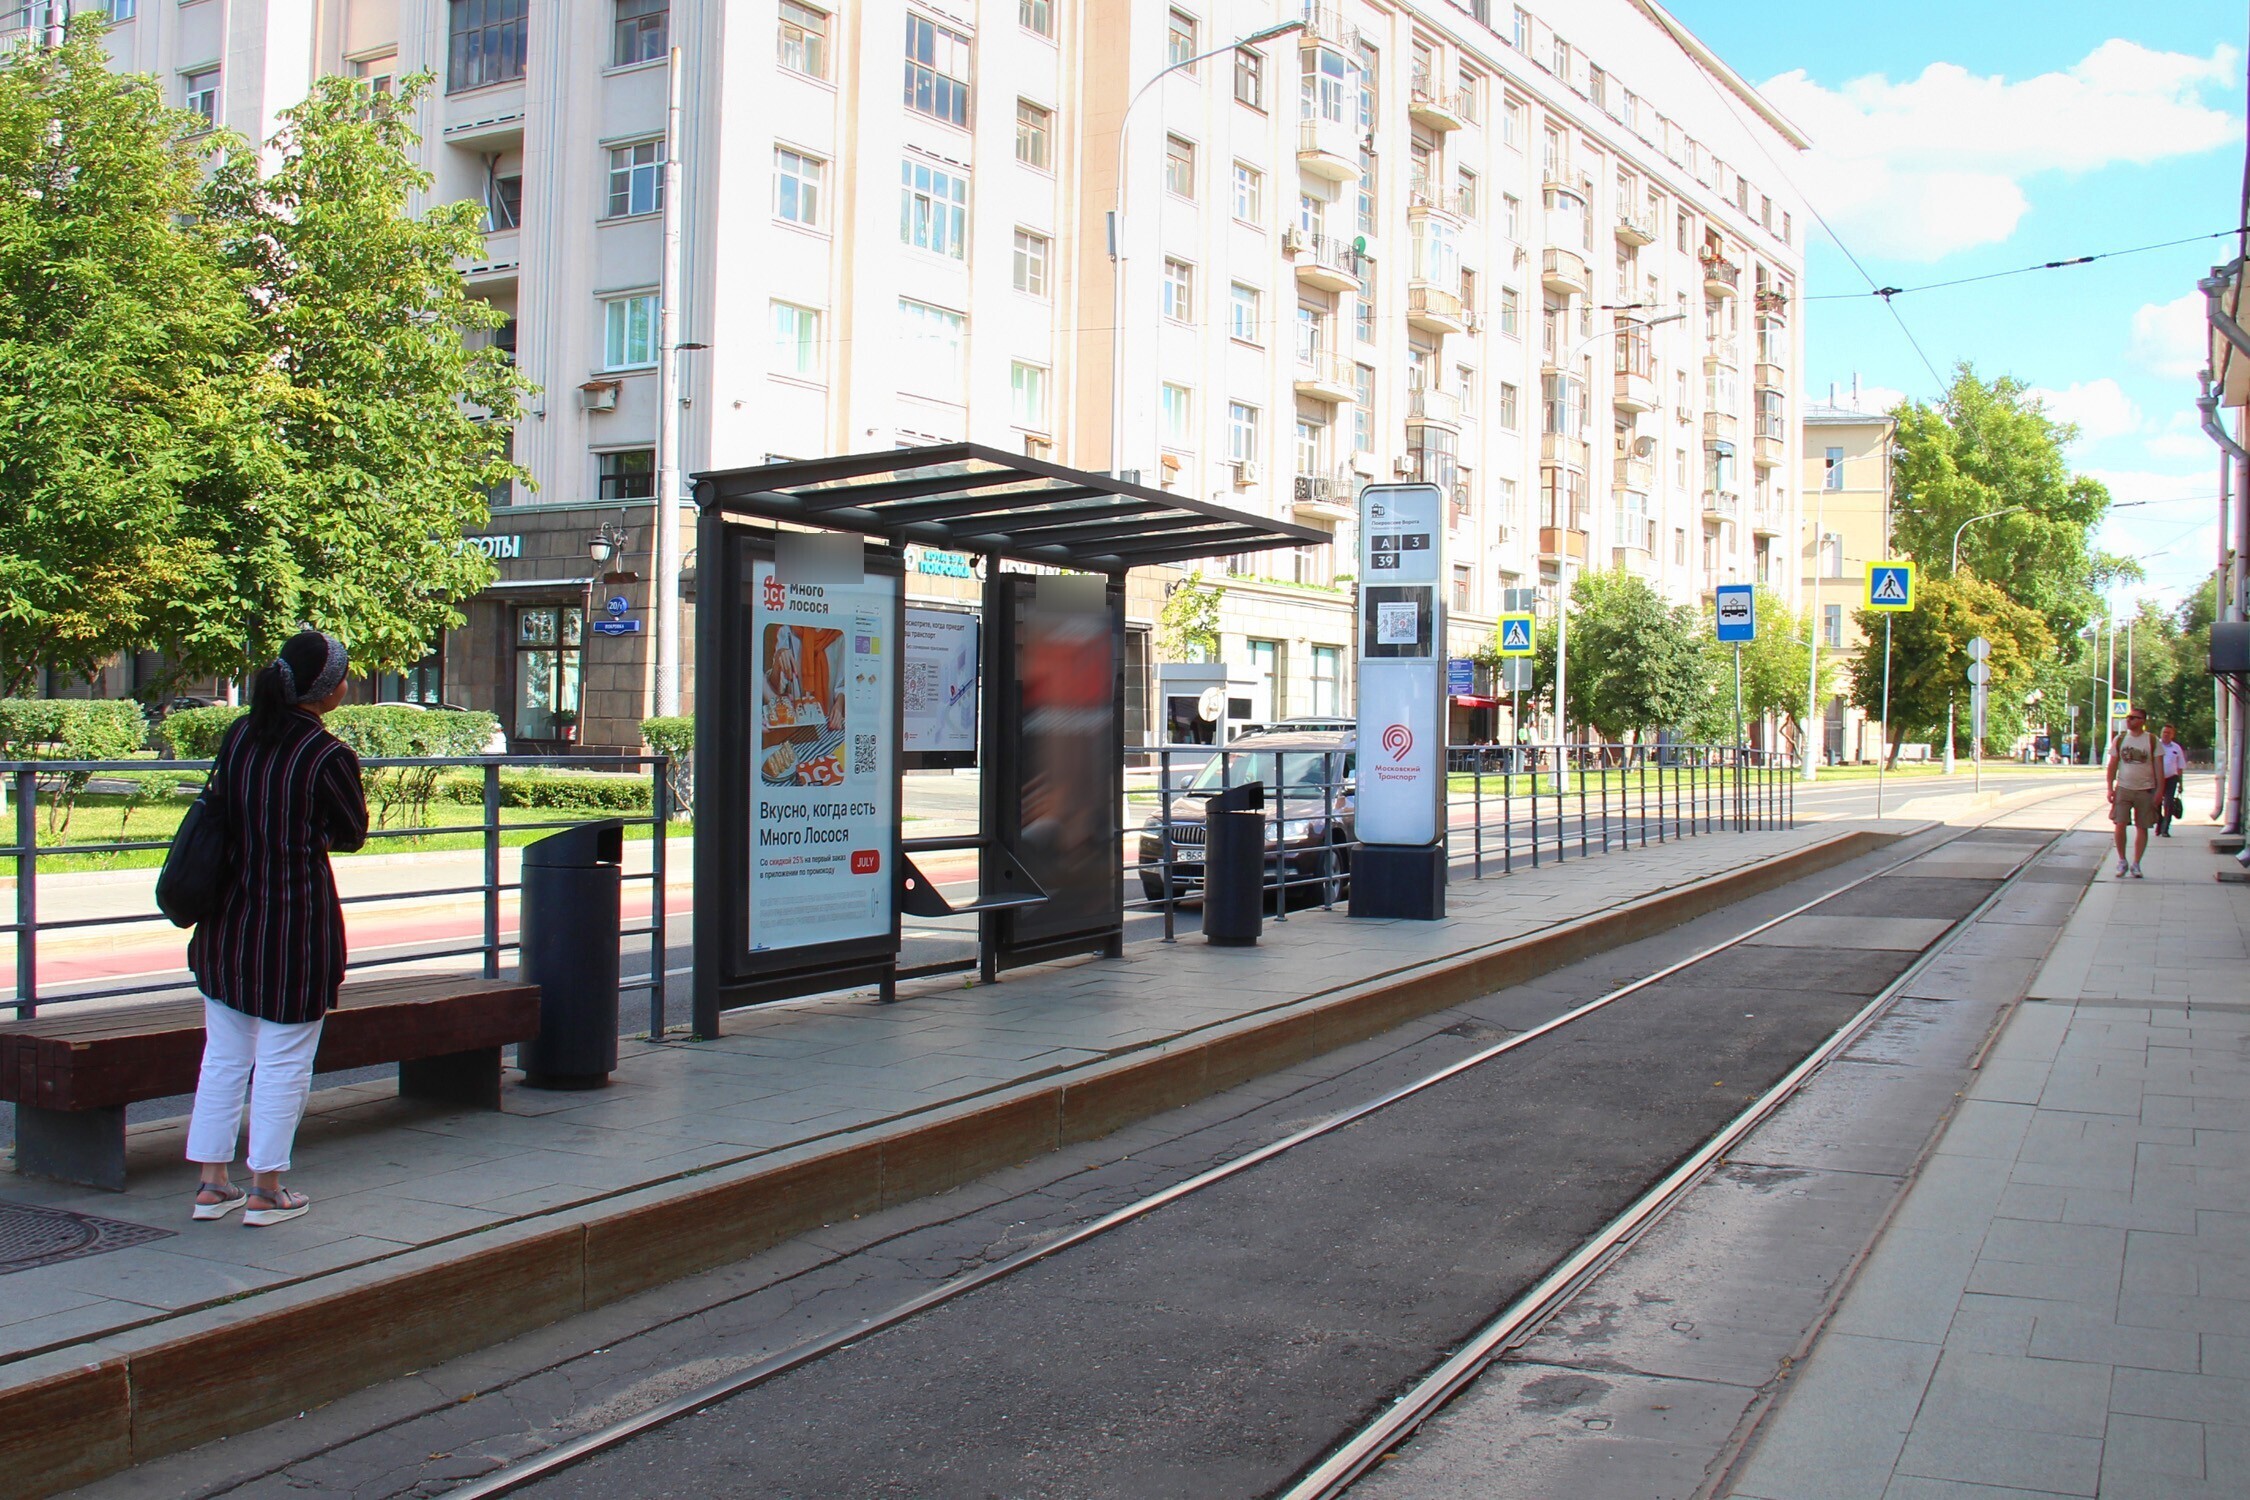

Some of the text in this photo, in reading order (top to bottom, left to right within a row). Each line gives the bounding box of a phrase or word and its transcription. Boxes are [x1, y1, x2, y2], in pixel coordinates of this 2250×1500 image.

[1412, 537, 1420, 548] 3
[1378, 555, 1394, 567] 39
[919, 561, 970, 578] ПОКРОВКА
[789, 600, 829, 614] лосося
[905, 620, 931, 629] осмотрите,
[1379, 773, 1416, 781] Транспорт
[760, 801, 876, 823] Вкусно, когда есть
[760, 827, 849, 846] Много Лосося
[760, 858, 769, 866] Со
[769, 857, 792, 866] скидкой
[792, 855, 803, 865] 25%
[812, 853, 831, 864] первый
[832, 853, 847, 861] заказ
[857, 857, 874, 867] JULY
[765, 868, 798, 880] приложении
[807, 866, 835, 876] промокоду
